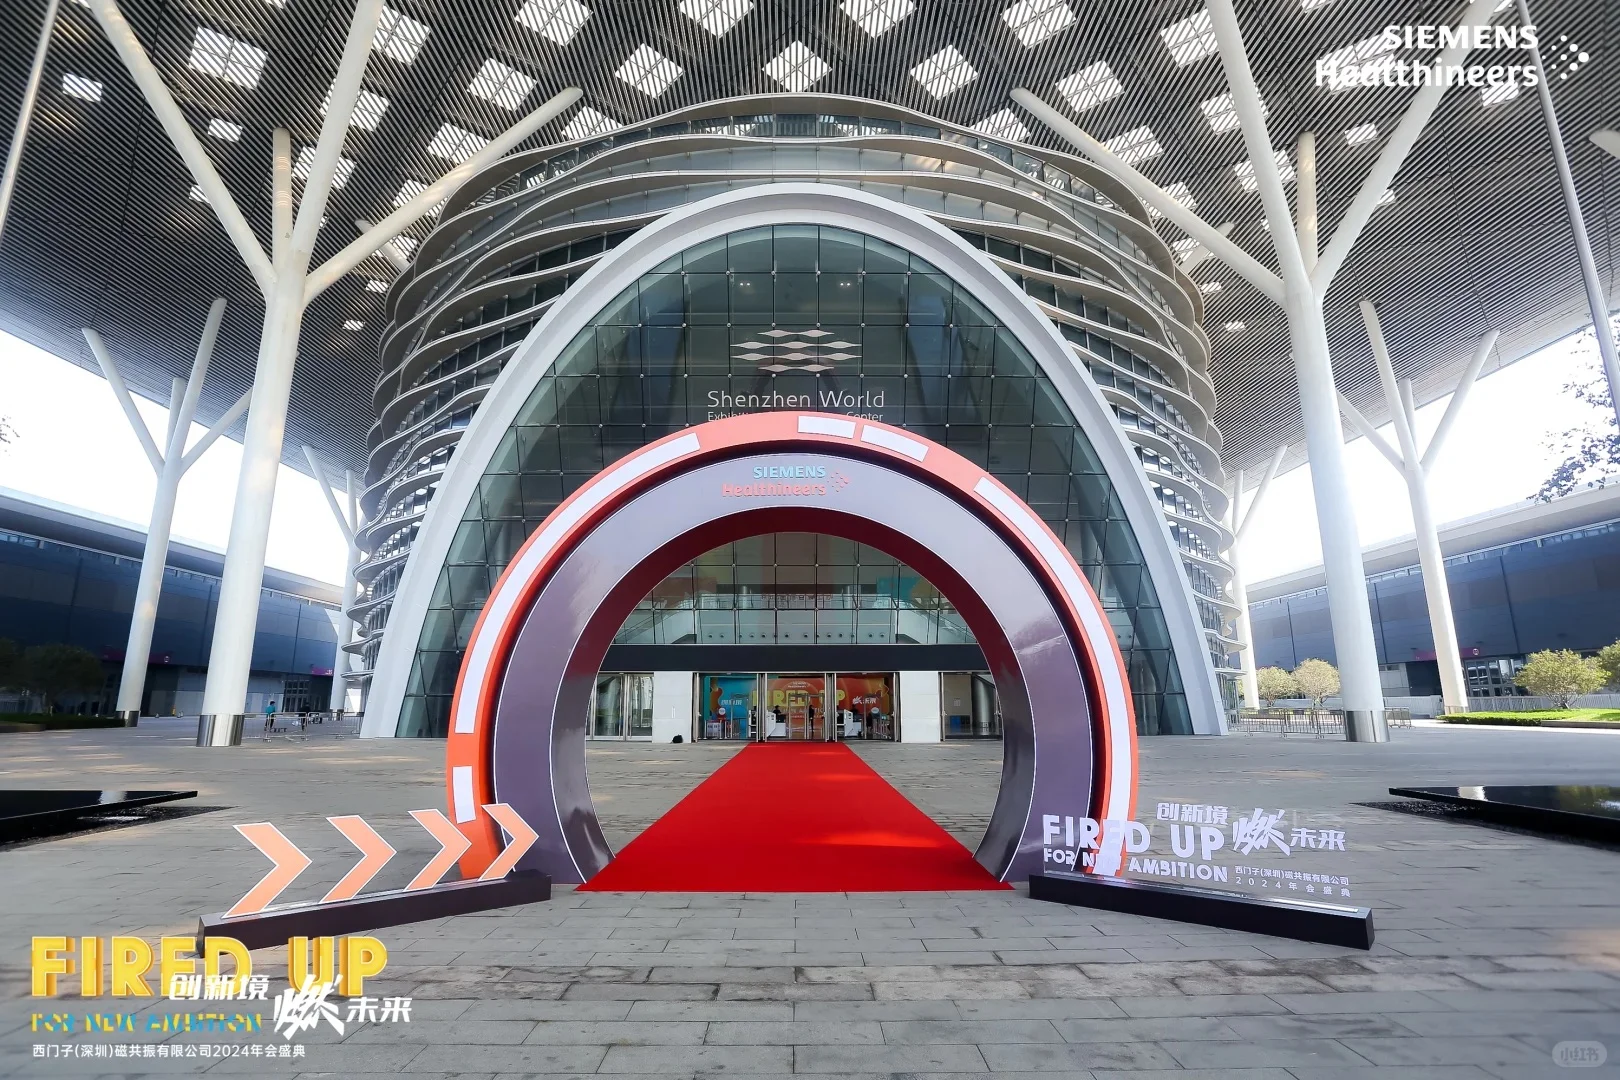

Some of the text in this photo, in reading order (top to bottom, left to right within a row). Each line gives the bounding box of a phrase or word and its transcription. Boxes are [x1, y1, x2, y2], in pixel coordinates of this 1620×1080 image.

[707, 390, 885, 408] Shenzhen World
[753, 465, 826, 478] SIEMENS
[722, 482, 826, 497] Healthineers
[1157, 802, 1228, 826] 创新境
[1043, 814, 1225, 861] FIRED UP
[1043, 848, 1076, 866] FOR
[1128, 856, 1228, 883] AMBITION
